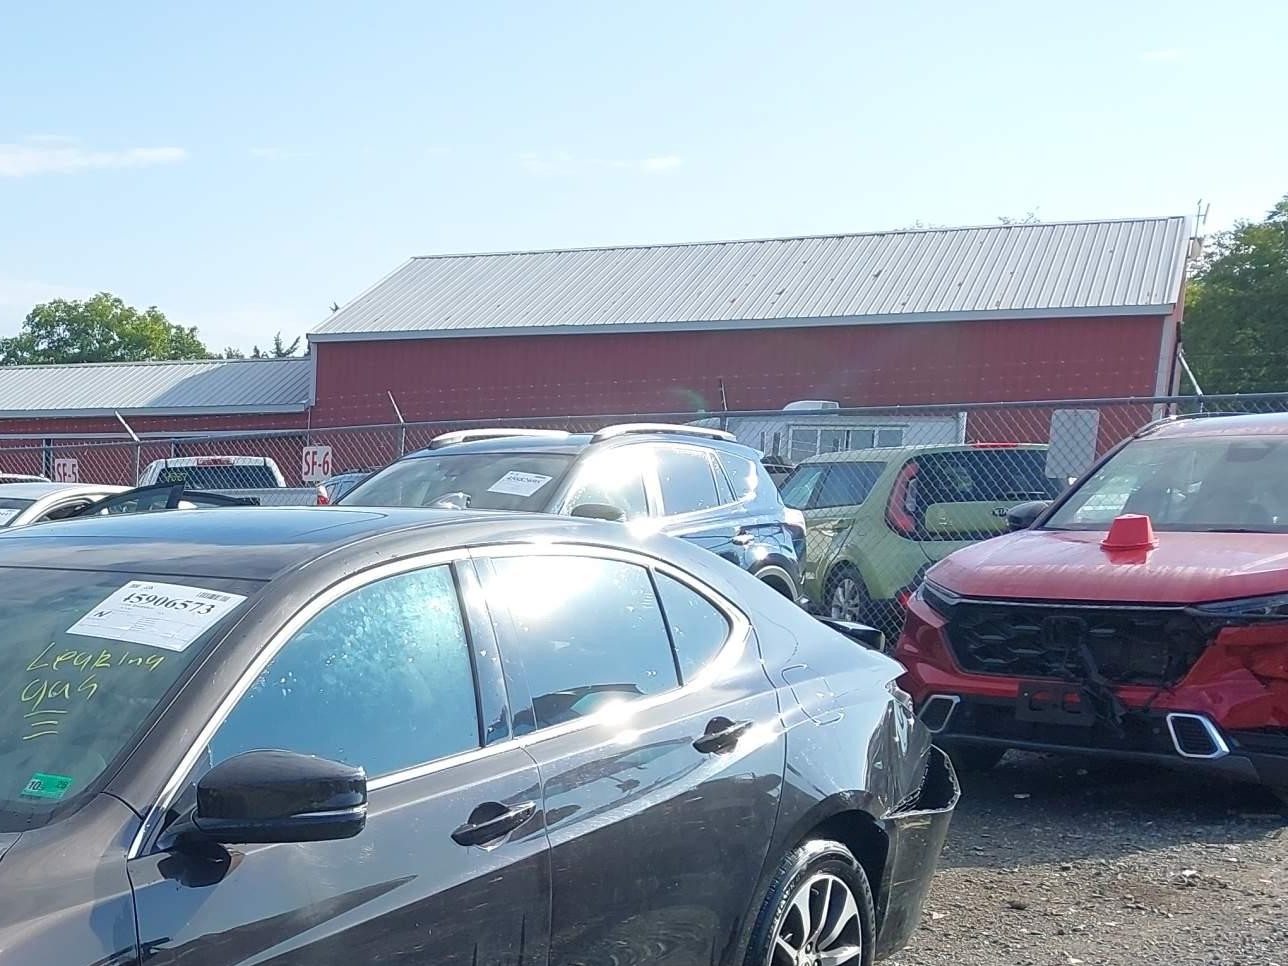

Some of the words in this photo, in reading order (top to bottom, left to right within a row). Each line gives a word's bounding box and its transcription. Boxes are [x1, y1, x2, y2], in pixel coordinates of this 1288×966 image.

[56, 462, 77, 483] SF-5
[304, 450, 330, 476] SF-6
[28, 780, 42, 791] 10
